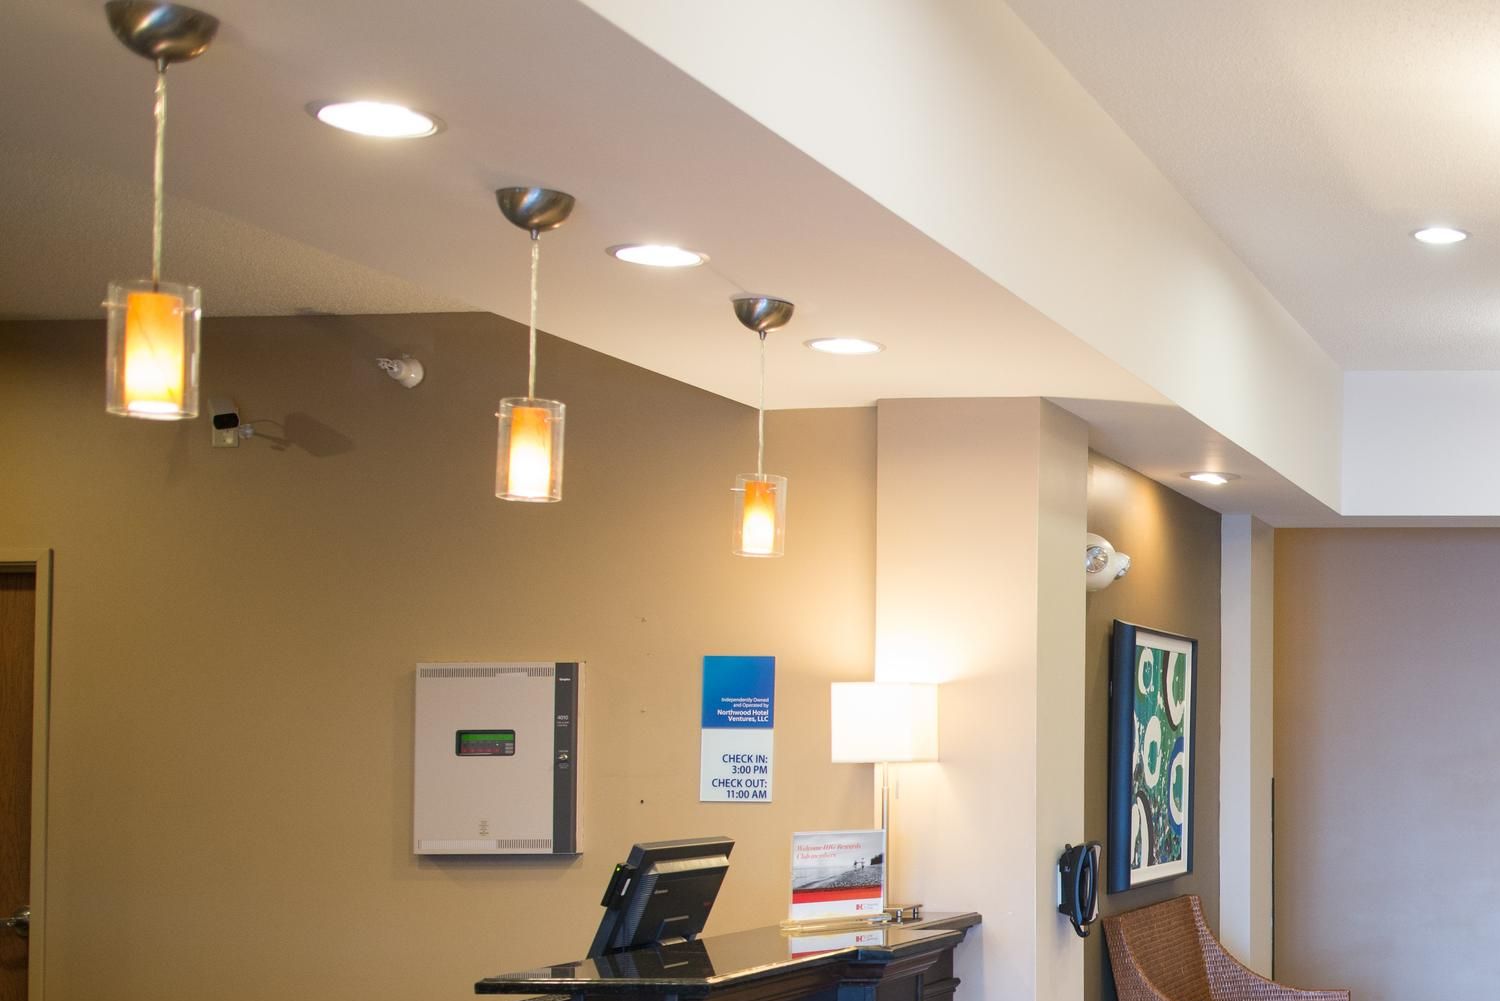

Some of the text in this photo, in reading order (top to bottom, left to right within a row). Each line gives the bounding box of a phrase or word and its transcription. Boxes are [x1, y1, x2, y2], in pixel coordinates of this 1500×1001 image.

[722, 753, 768, 763] CHECK IN:
[731, 765, 768, 774] 3:00 PM
[711, 778, 768, 788] CHECK OUT:
[726, 790, 767, 799] 11:00 AM
